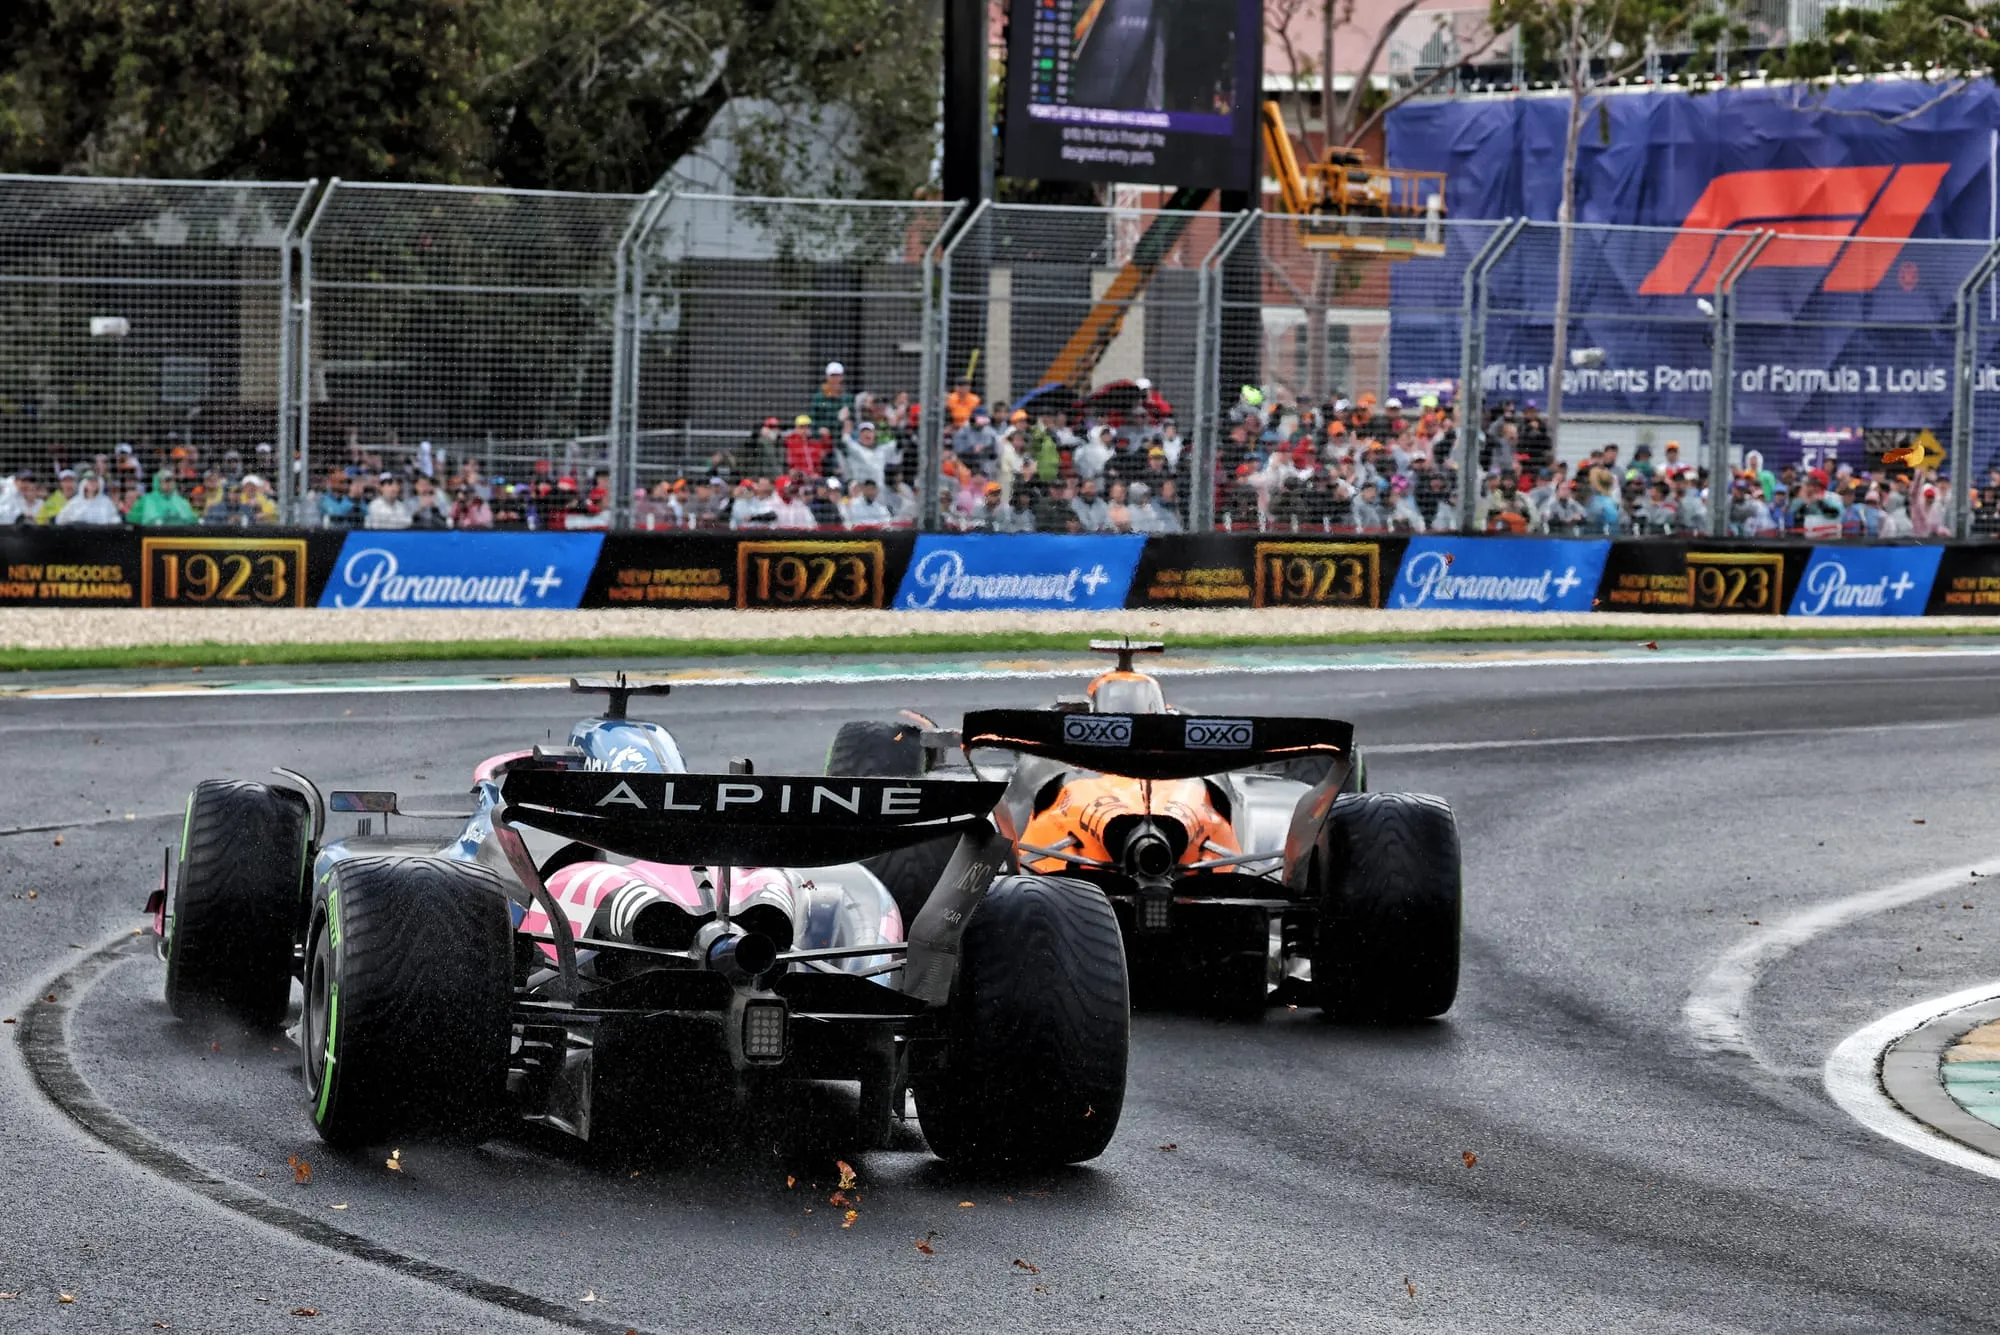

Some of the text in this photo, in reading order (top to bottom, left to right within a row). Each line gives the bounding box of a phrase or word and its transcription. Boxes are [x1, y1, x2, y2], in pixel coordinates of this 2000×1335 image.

[1551, 364, 1650, 394] ayments
[1655, 364, 1737, 393] Partn
[1741, 364, 1768, 392] of
[1770, 364, 1860, 392] Formula
[1864, 365, 1882, 393] 1
[1886, 363, 1947, 392] Louis
[160, 553, 287, 601] 1923
[335, 547, 562, 608] Paramount+
[753, 554, 868, 600] 1923
[905, 549, 1110, 608] Paramount+
[1271, 556, 1364, 601] 1923
[1400, 551, 1582, 608] Paramount+
[1066, 719, 1131, 745] OXXO
[1187, 721, 1250, 747] OXXO
[595, 780, 922, 815] ALPINE
